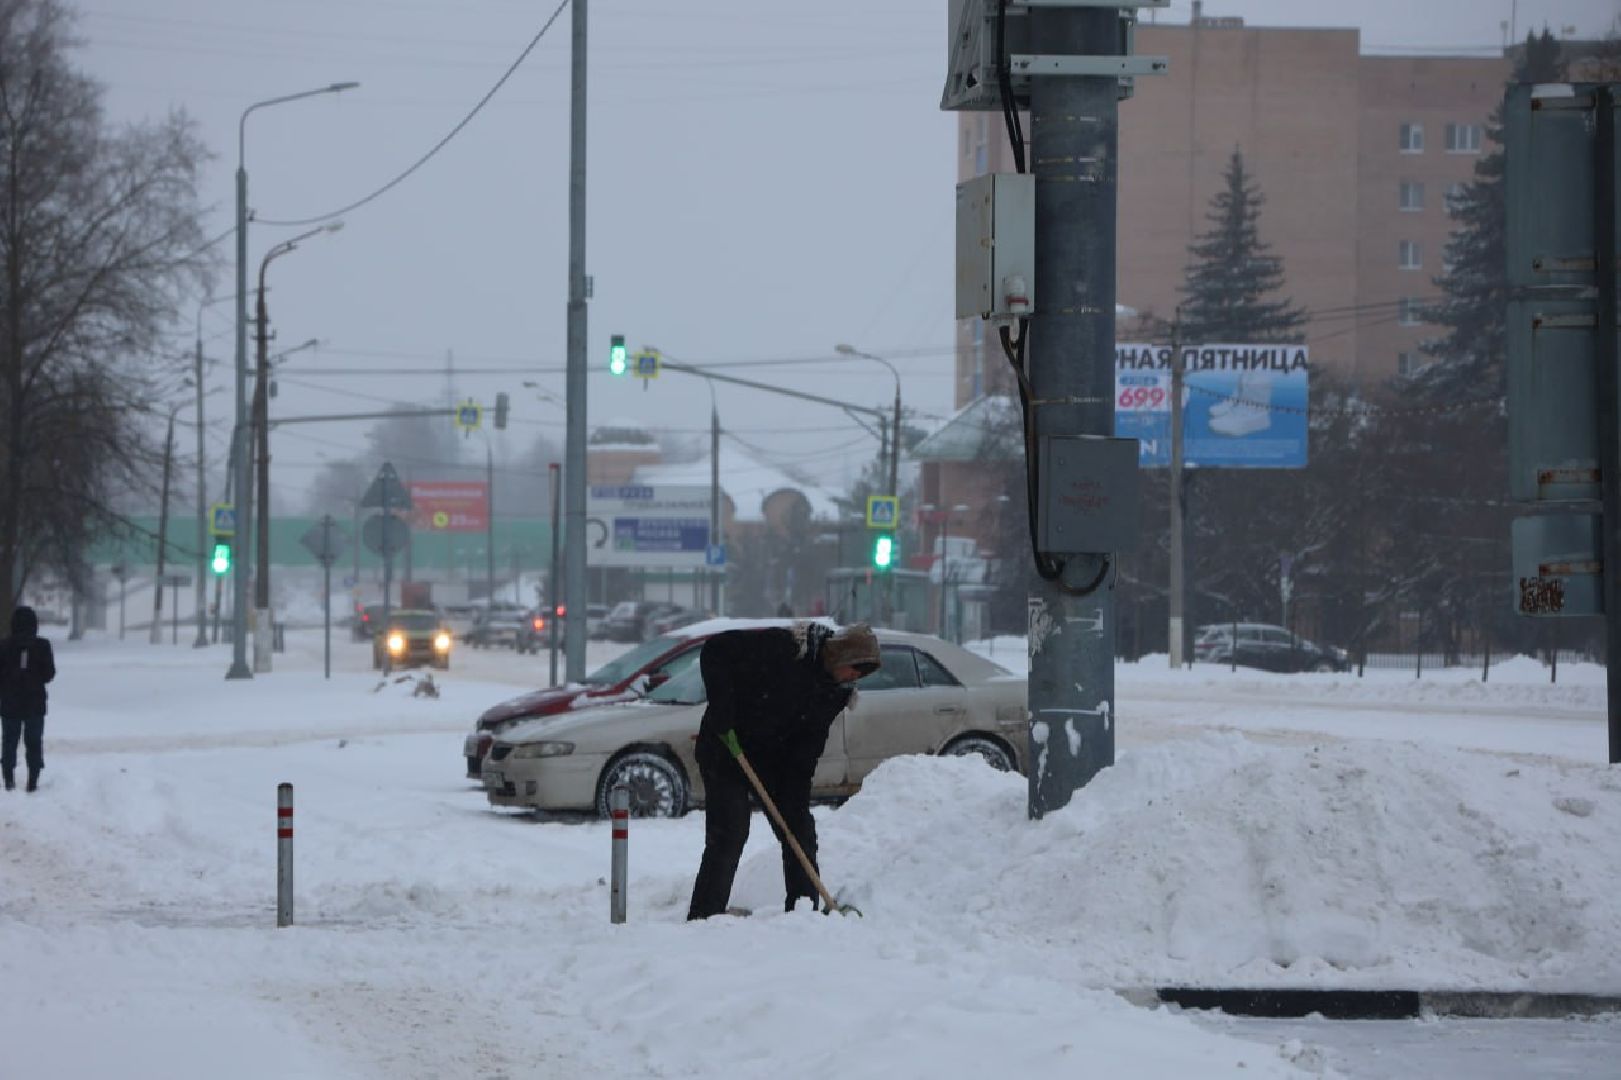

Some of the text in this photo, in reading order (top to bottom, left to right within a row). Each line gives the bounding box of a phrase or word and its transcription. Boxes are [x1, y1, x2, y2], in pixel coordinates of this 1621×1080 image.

[1115, 348, 1309, 373] НАЯ ПЯТНИЦА
[1119, 387, 1165, 407] 699
